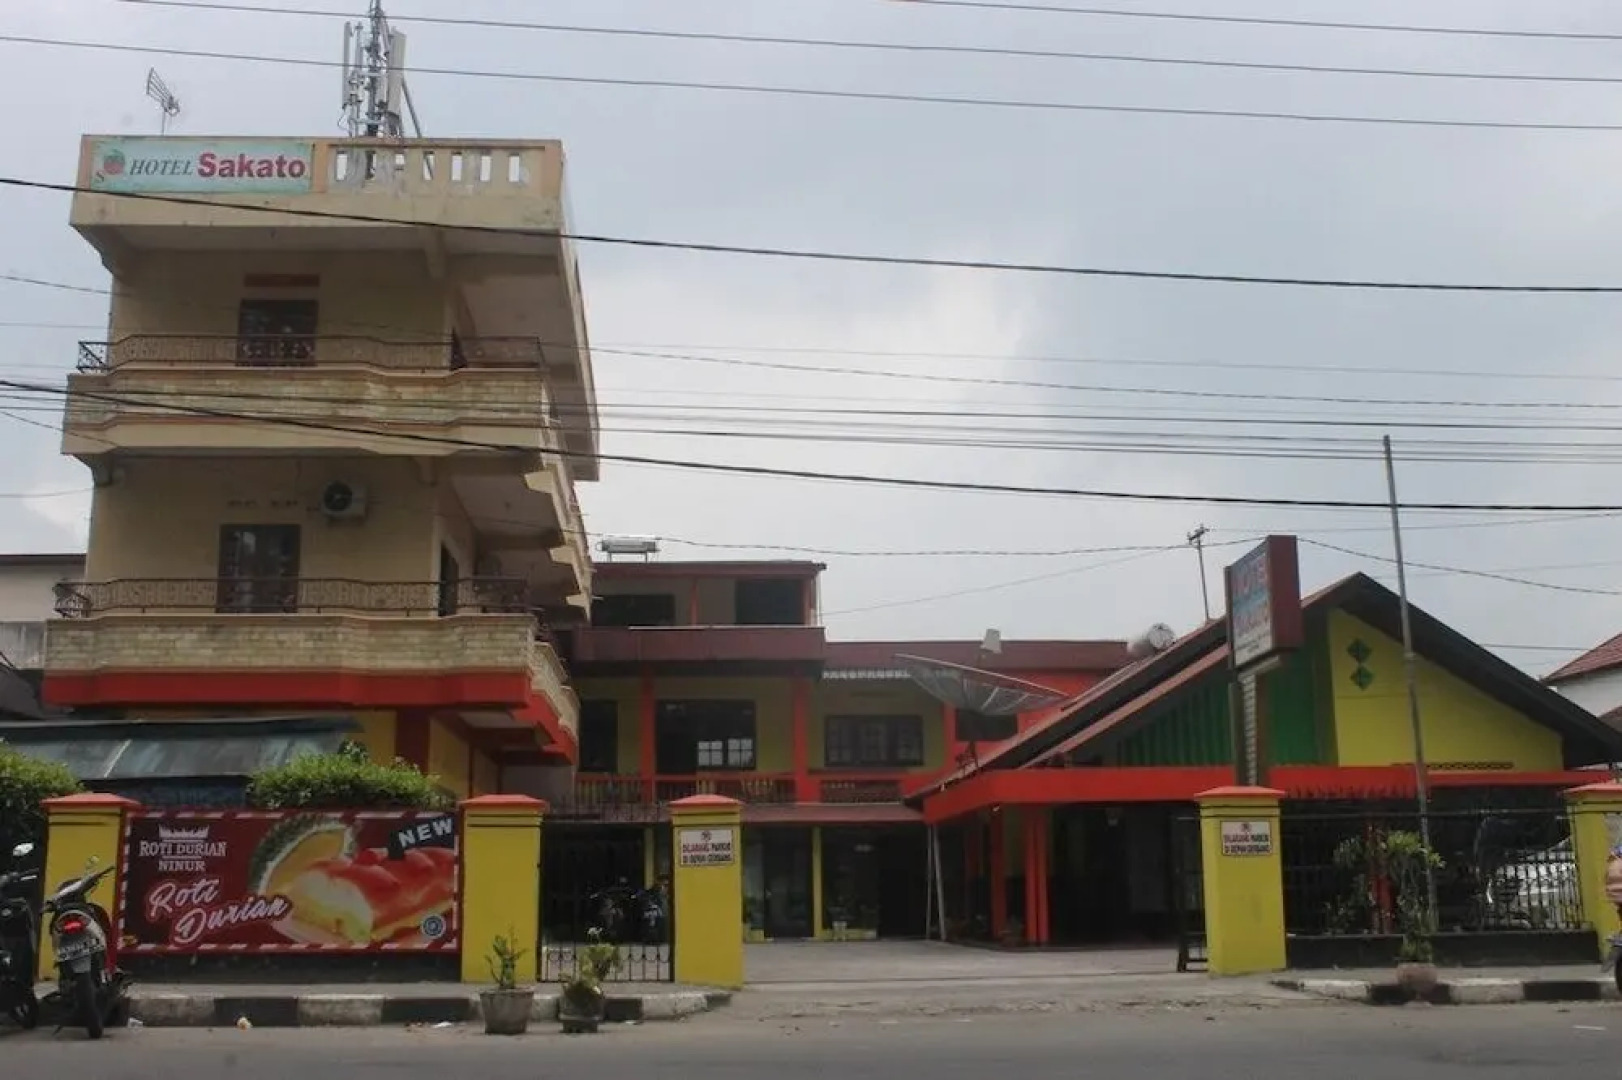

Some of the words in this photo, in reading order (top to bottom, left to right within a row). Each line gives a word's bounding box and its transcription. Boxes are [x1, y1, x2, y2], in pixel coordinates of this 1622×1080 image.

[129, 157, 194, 176] HOTEL
[197, 152, 306, 178] Sakato
[398, 818, 453, 848] NEW
[139, 840, 173, 857] ROTI
[176, 841, 227, 857] DURIAN
[159, 860, 206, 871] NINUR
[149, 878, 220, 917] Roti
[174, 896, 288, 944] Durian
